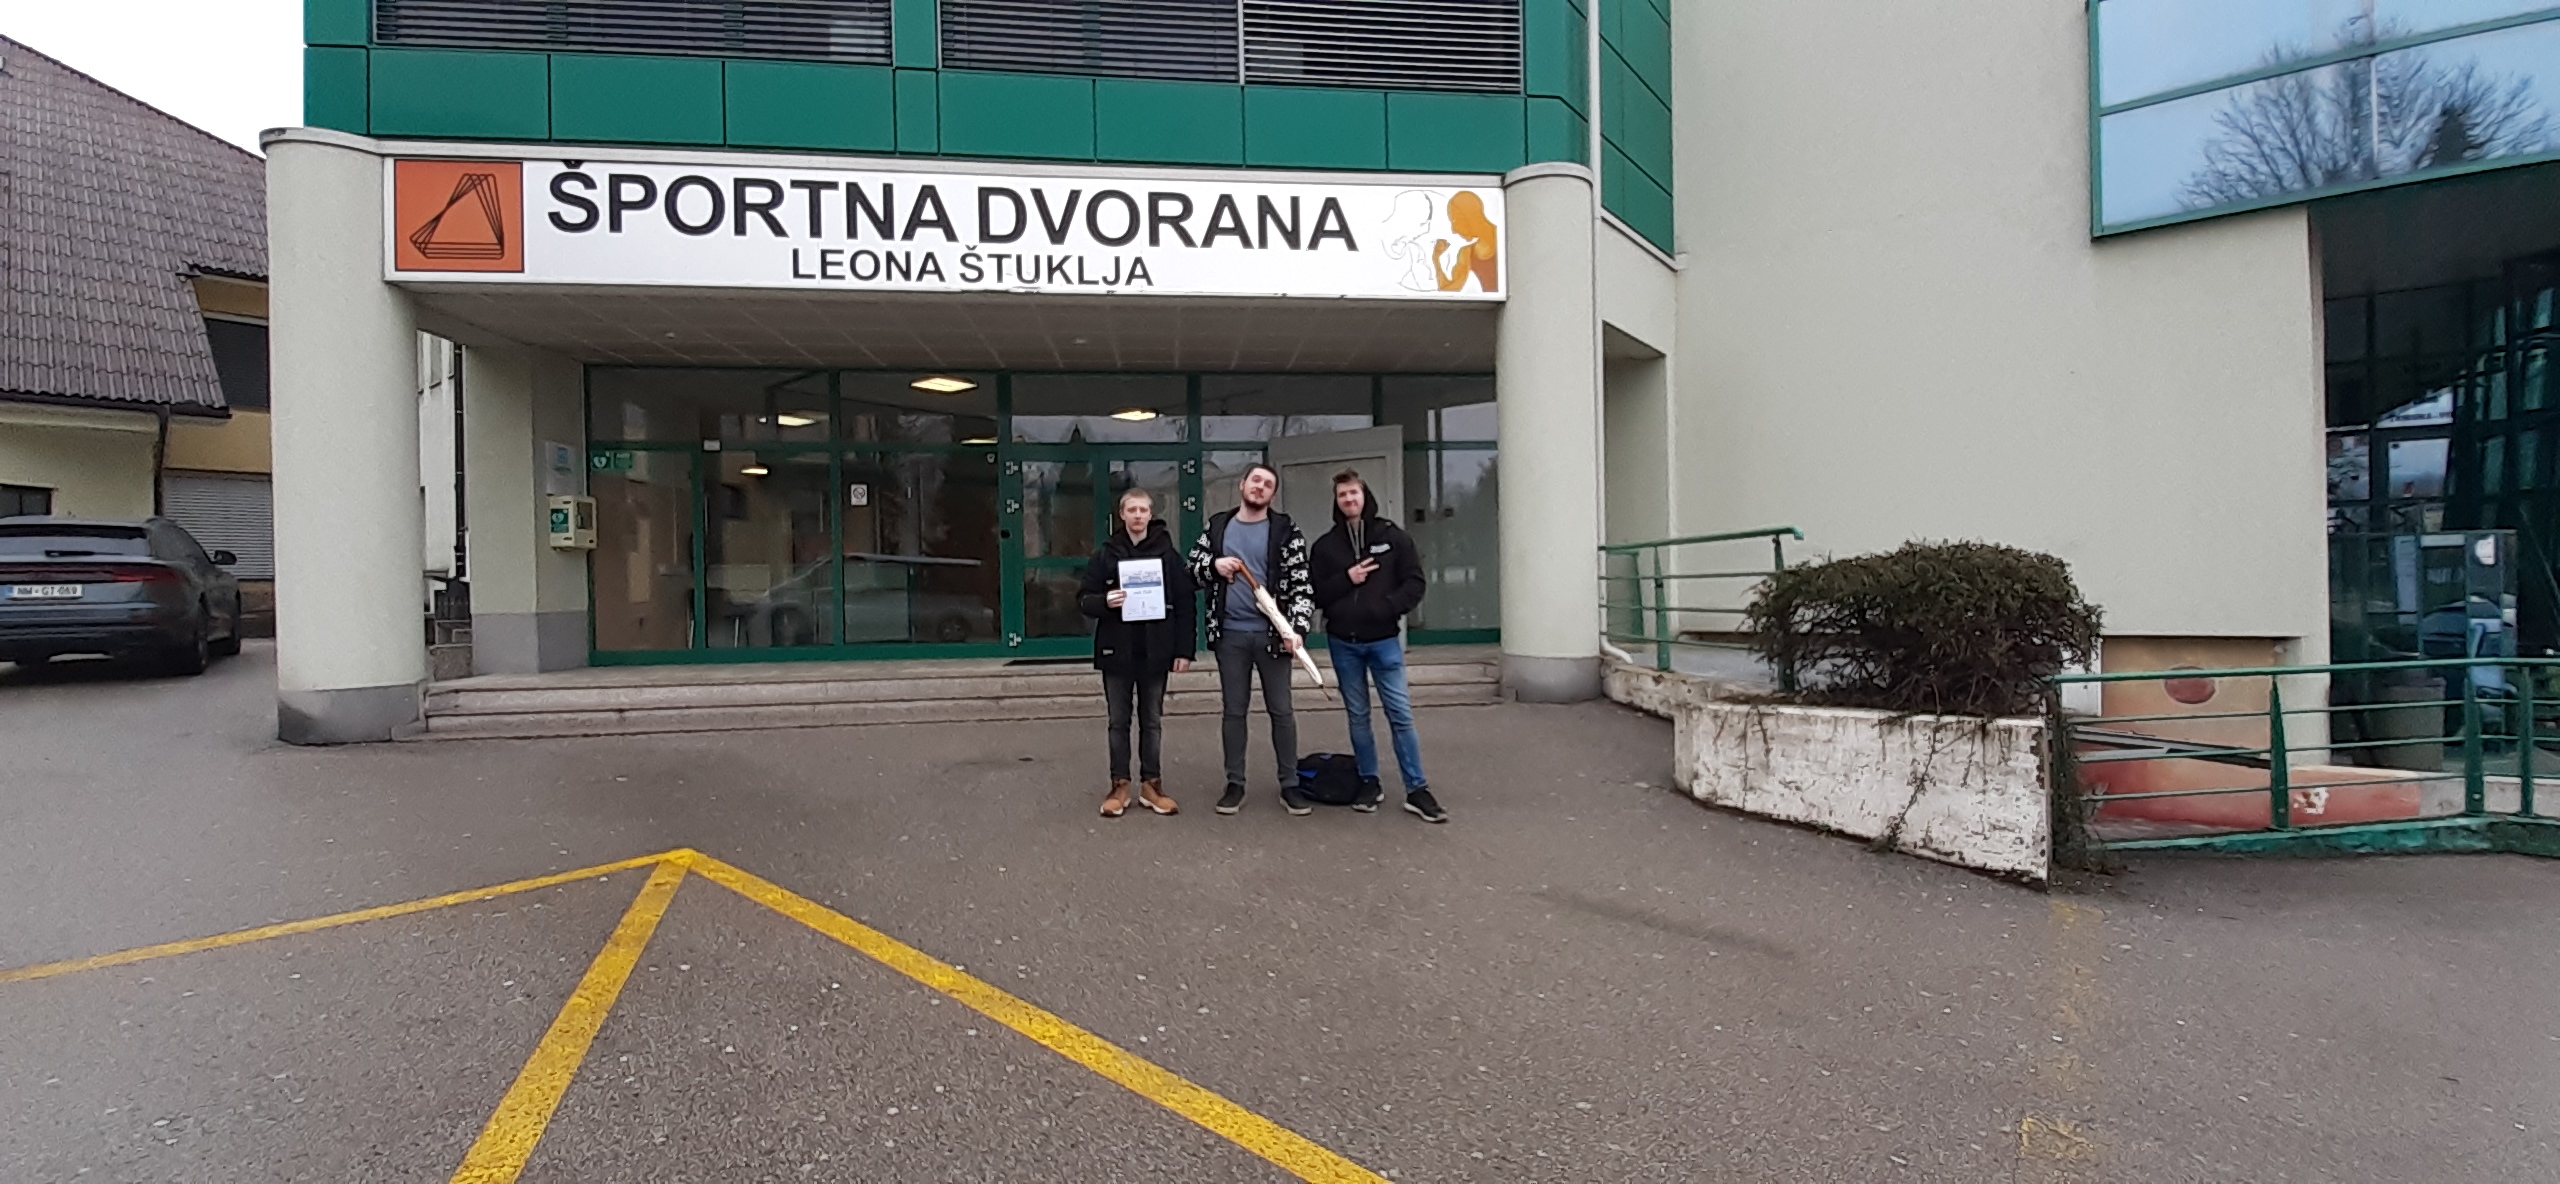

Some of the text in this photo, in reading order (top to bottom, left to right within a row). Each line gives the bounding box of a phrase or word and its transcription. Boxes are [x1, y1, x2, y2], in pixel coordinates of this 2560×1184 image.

[548, 159, 1360, 252] ŠPORTNA DVORANA
[792, 245, 1154, 286] LEONA ŠTUKLJA
